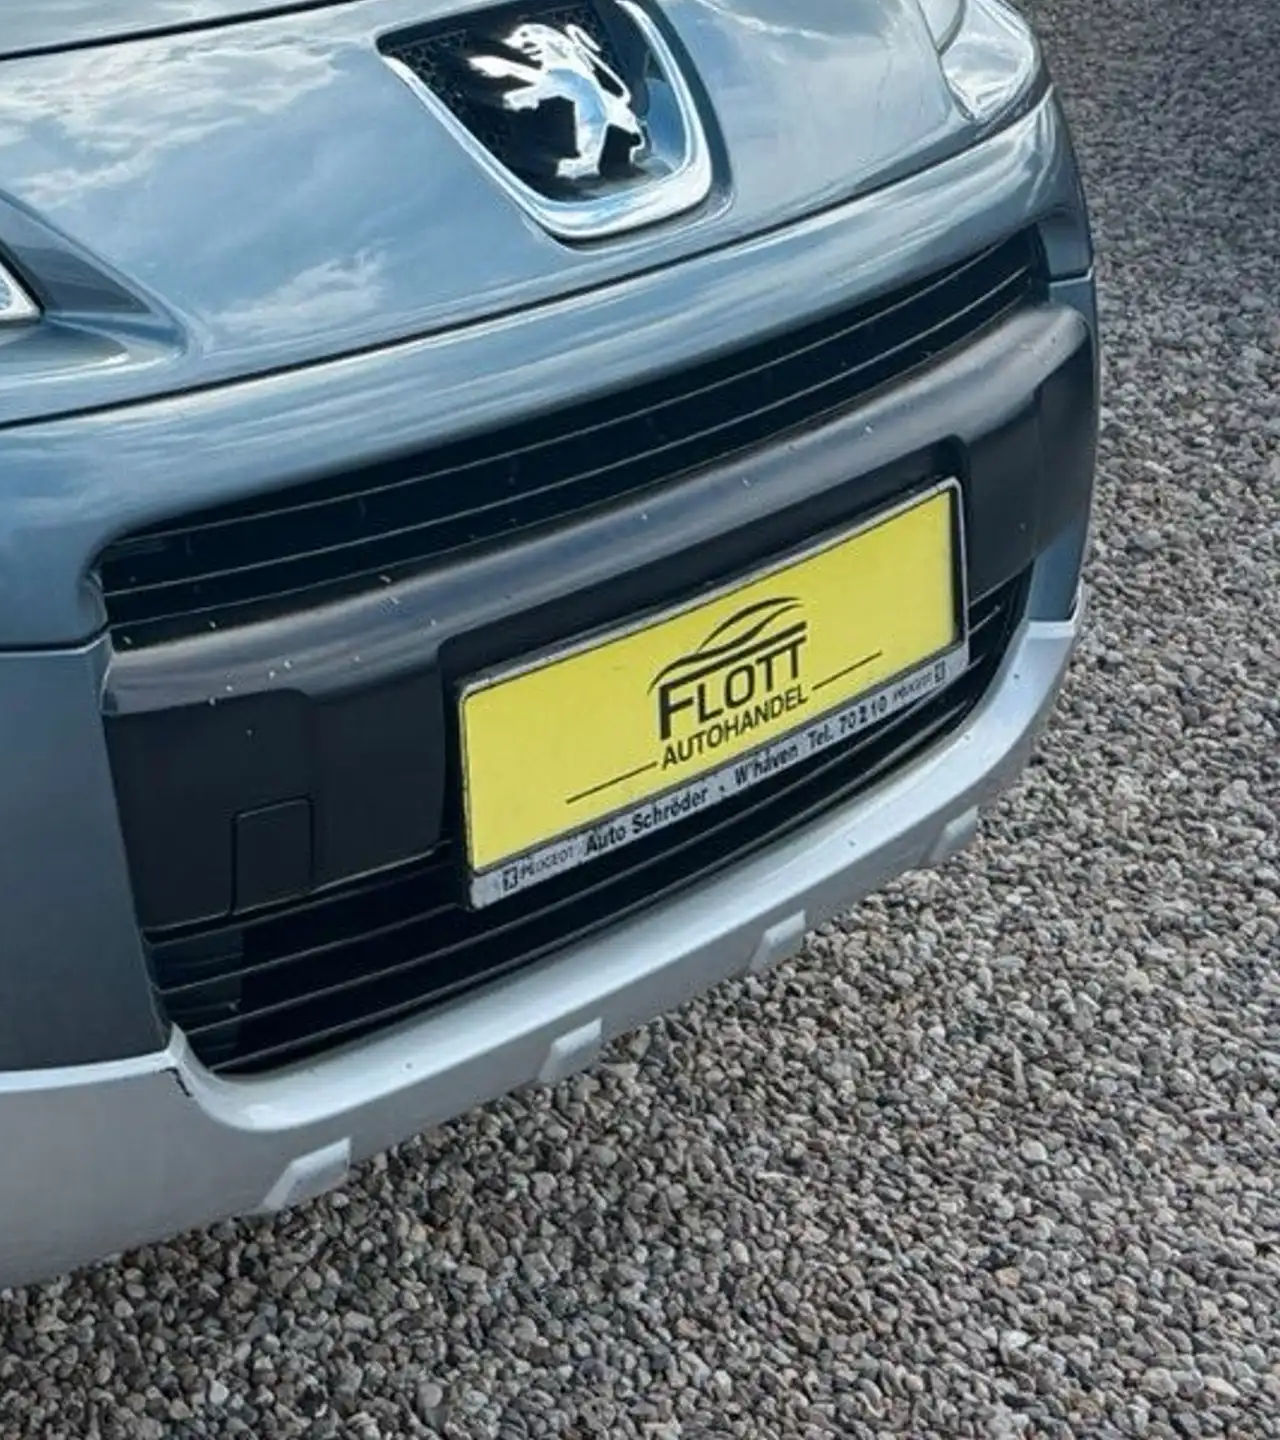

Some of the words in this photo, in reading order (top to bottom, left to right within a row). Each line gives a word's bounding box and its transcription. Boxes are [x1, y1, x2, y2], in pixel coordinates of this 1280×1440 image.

[659, 620, 807, 741] FLOTT
[662, 683, 809, 771] AUTOHANDEL
[584, 822, 627, 856] Auto
[631, 786, 709, 835] Schröder
[807, 723, 835, 750] Tel.
